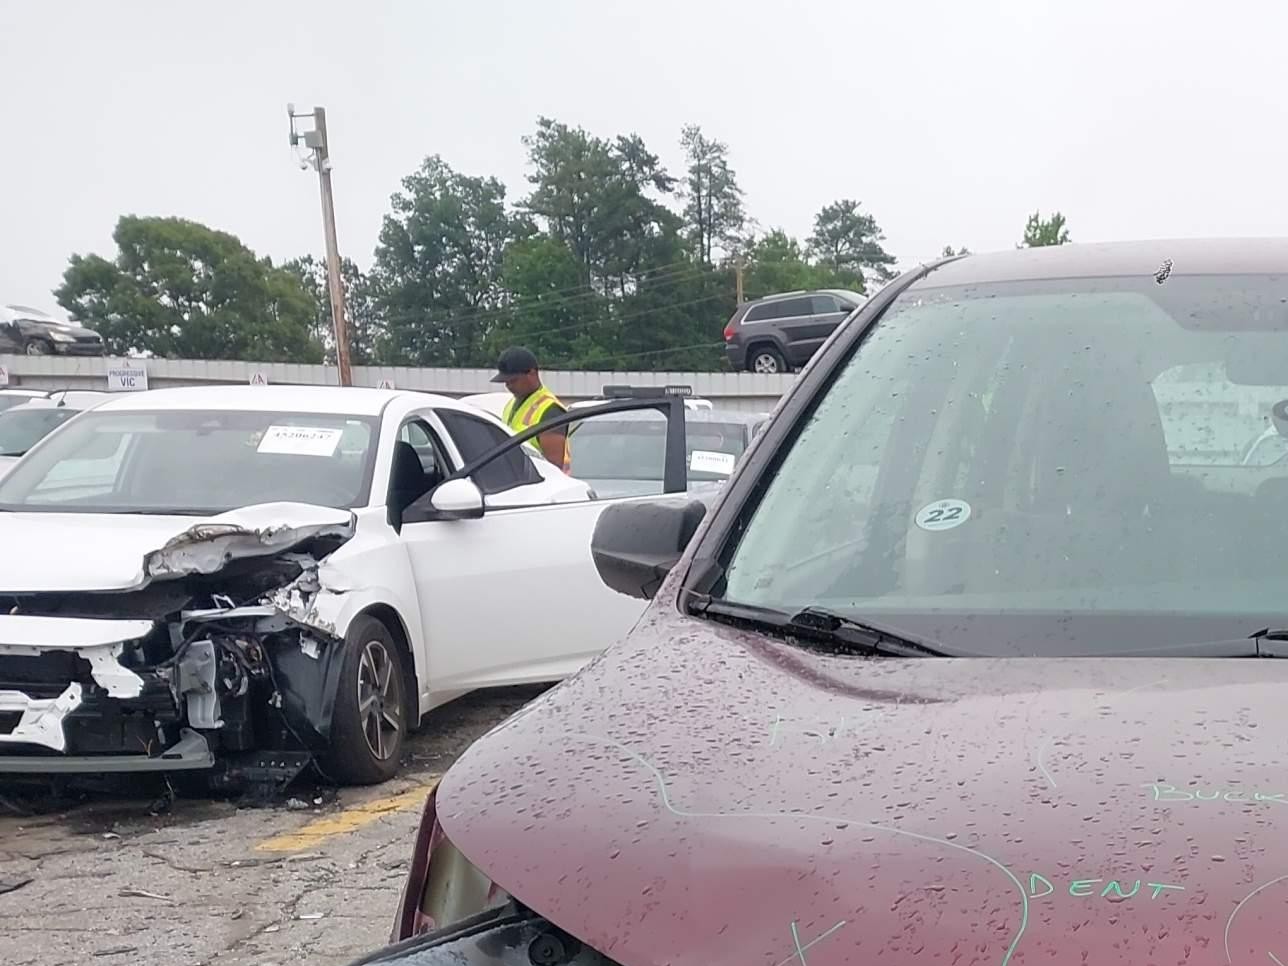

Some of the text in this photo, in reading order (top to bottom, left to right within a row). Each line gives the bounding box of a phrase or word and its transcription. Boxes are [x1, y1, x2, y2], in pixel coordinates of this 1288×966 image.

[120, 376, 136, 387] VIC
[923, 506, 963, 524] 22
[1029, 872, 1186, 901] DENT
